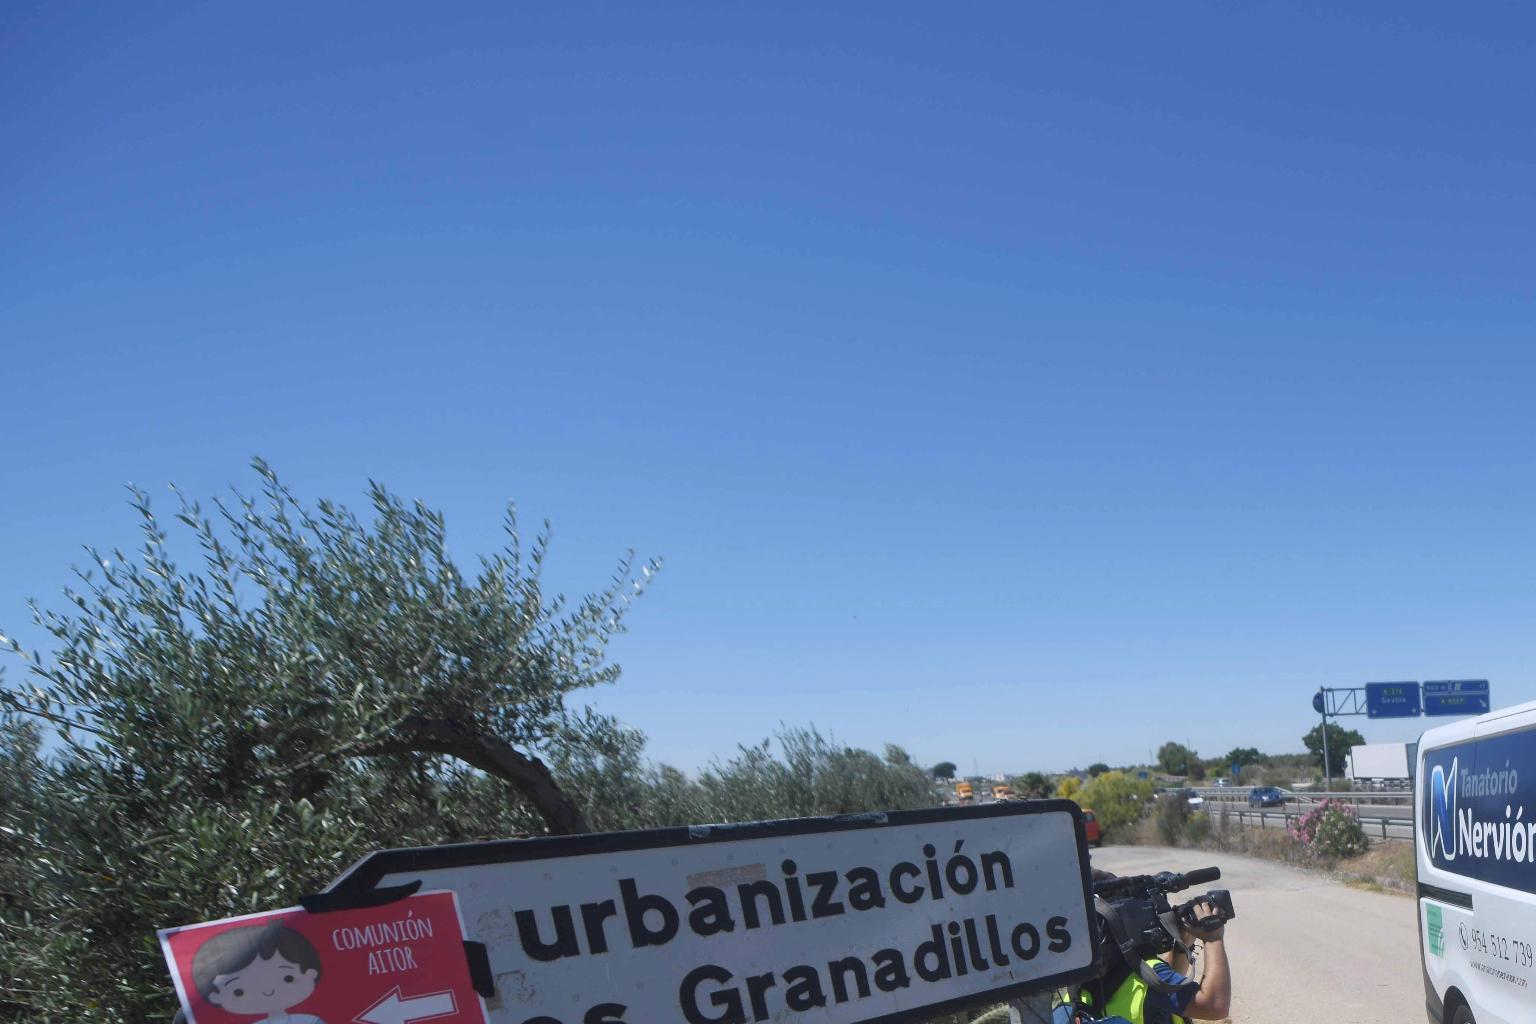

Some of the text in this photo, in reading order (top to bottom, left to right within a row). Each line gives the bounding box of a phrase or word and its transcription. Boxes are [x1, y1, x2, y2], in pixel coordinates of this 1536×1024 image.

[1461, 760, 1518, 798] Tanatorio
[515, 840, 1015, 962] urbanización
[333, 910, 433, 951] COMUNIÓN
[1471, 928, 1488, 954] 954
[1491, 934, 1509, 961] 512
[1513, 940, 1533, 968] 739
[368, 947, 418, 975] AITOR
